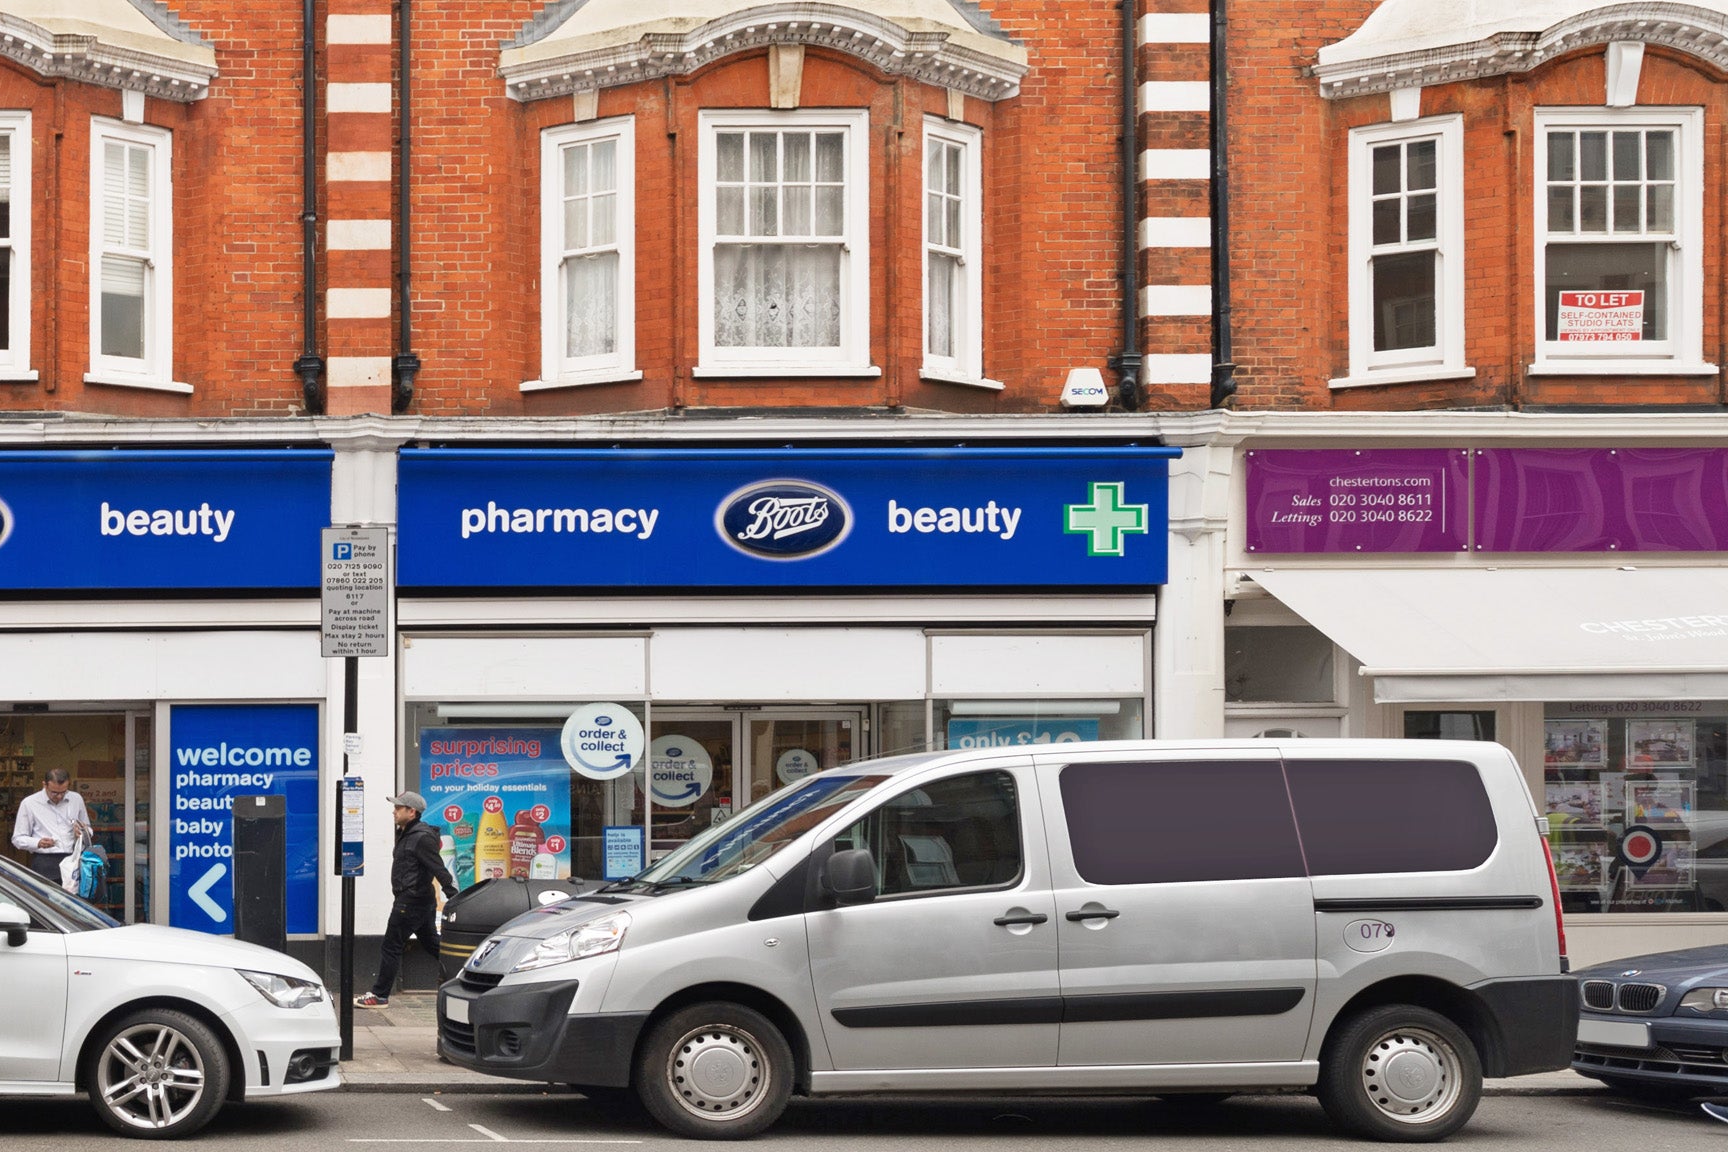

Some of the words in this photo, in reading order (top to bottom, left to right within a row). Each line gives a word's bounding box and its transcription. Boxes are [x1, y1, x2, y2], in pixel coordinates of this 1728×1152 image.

[1575, 294, 1596, 306] TO
[1600, 294, 1629, 306] LET
[1560, 311, 1641, 319] SELF-CONTAINED
[1567, 319, 1603, 327] STUDIO
[1605, 319, 1634, 327] FLATS
[1329, 475, 1431, 488] chestertons.com
[1291, 494, 1322, 507] Sales
[1329, 494, 1356, 506] 020
[1360, 494, 1394, 506] 3040
[1398, 494, 1432, 506] 8611
[101, 503, 234, 542] beauty
[462, 502, 658, 539] pharmacy
[738, 497, 828, 539] Boots
[889, 500, 1021, 539] beauty
[1271, 510, 1323, 525] Lettings
[1329, 510, 1356, 522] 020
[1360, 510, 1394, 522] 3040
[1398, 510, 1433, 522] 8622
[337, 544, 350, 559] P
[326, 584, 353, 592] quoting
[1569, 702, 1614, 714] Lettings
[1616, 702, 1639, 712] 020
[1641, 702, 1670, 712] 3040
[1672, 701, 1703, 711] 8622
[578, 728, 616, 739] order
[618, 729, 627, 740] &
[430, 736, 541, 758] surprising
[580, 741, 625, 752] collect
[960, 732, 1011, 750] only
[177, 743, 311, 765] welcome
[430, 759, 499, 780] prices
[651, 759, 685, 770] order
[176, 770, 274, 789] pharmacy
[653, 771, 694, 781] collect
[444, 785, 465, 794] your
[467, 783, 500, 793] holiday
[502, 783, 547, 792] essentials
[176, 794, 234, 810] beaut
[176, 818, 223, 837] baby
[176, 841, 233, 861] photo
[511, 846, 537, 855] Blends
